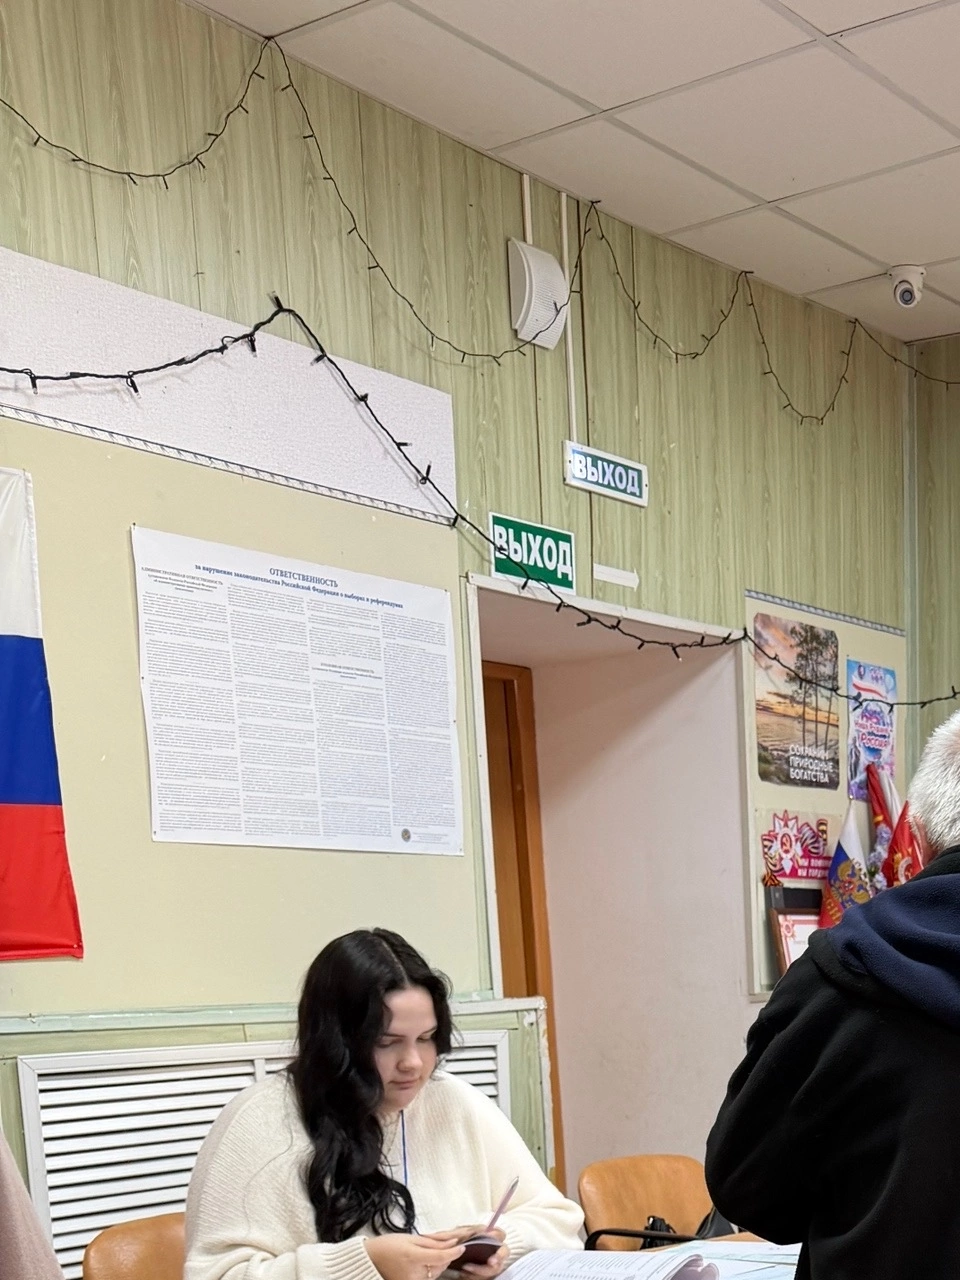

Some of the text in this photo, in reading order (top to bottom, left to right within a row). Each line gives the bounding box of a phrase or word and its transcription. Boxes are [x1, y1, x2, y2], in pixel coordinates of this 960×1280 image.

[572, 452, 641, 496] ВЫХОД
[494, 524, 573, 581] ВЫХОД
[202, 566, 233, 577] нарушение
[234, 572, 281, 585] законодательства
[281, 580, 311, 591] Российской
[312, 585, 339, 597] Федерации
[344, 593, 365, 602] выборах
[370, 598, 403, 609] референдумах
[269, 567, 339, 588] ОТВЕТСТВЕННОСТЬ
[860, 732, 889, 748] Россия
[790, 756, 834, 772] ПРИРОДНЫЕ
[790, 768, 829, 783] БОГАТСТВА
